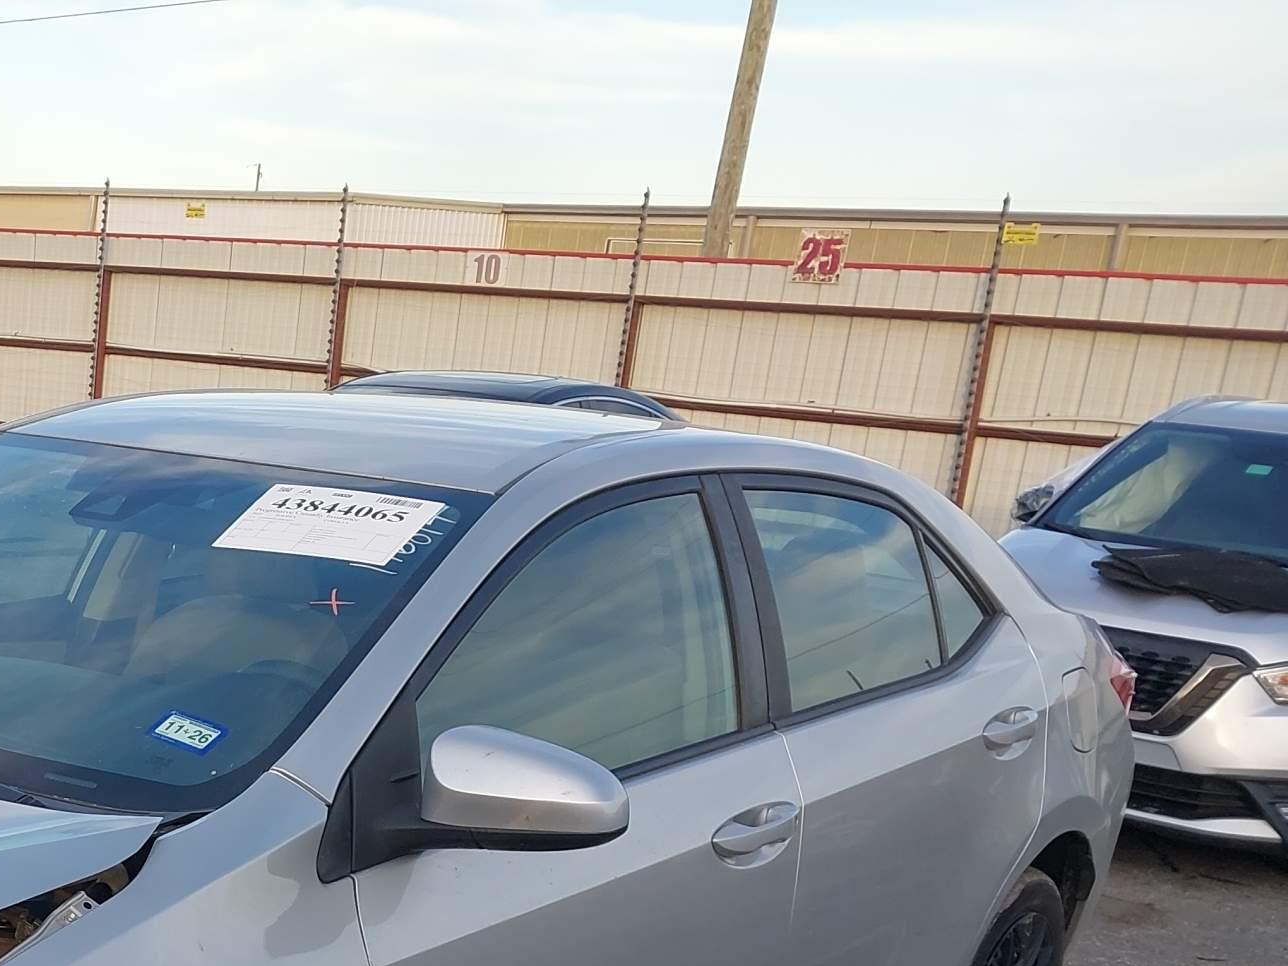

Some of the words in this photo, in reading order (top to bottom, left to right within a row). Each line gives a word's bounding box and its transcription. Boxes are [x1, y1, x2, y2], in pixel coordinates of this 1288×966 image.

[474, 254, 501, 284] 10
[793, 236, 844, 276] 25
[272, 497, 409, 523] 43844065
